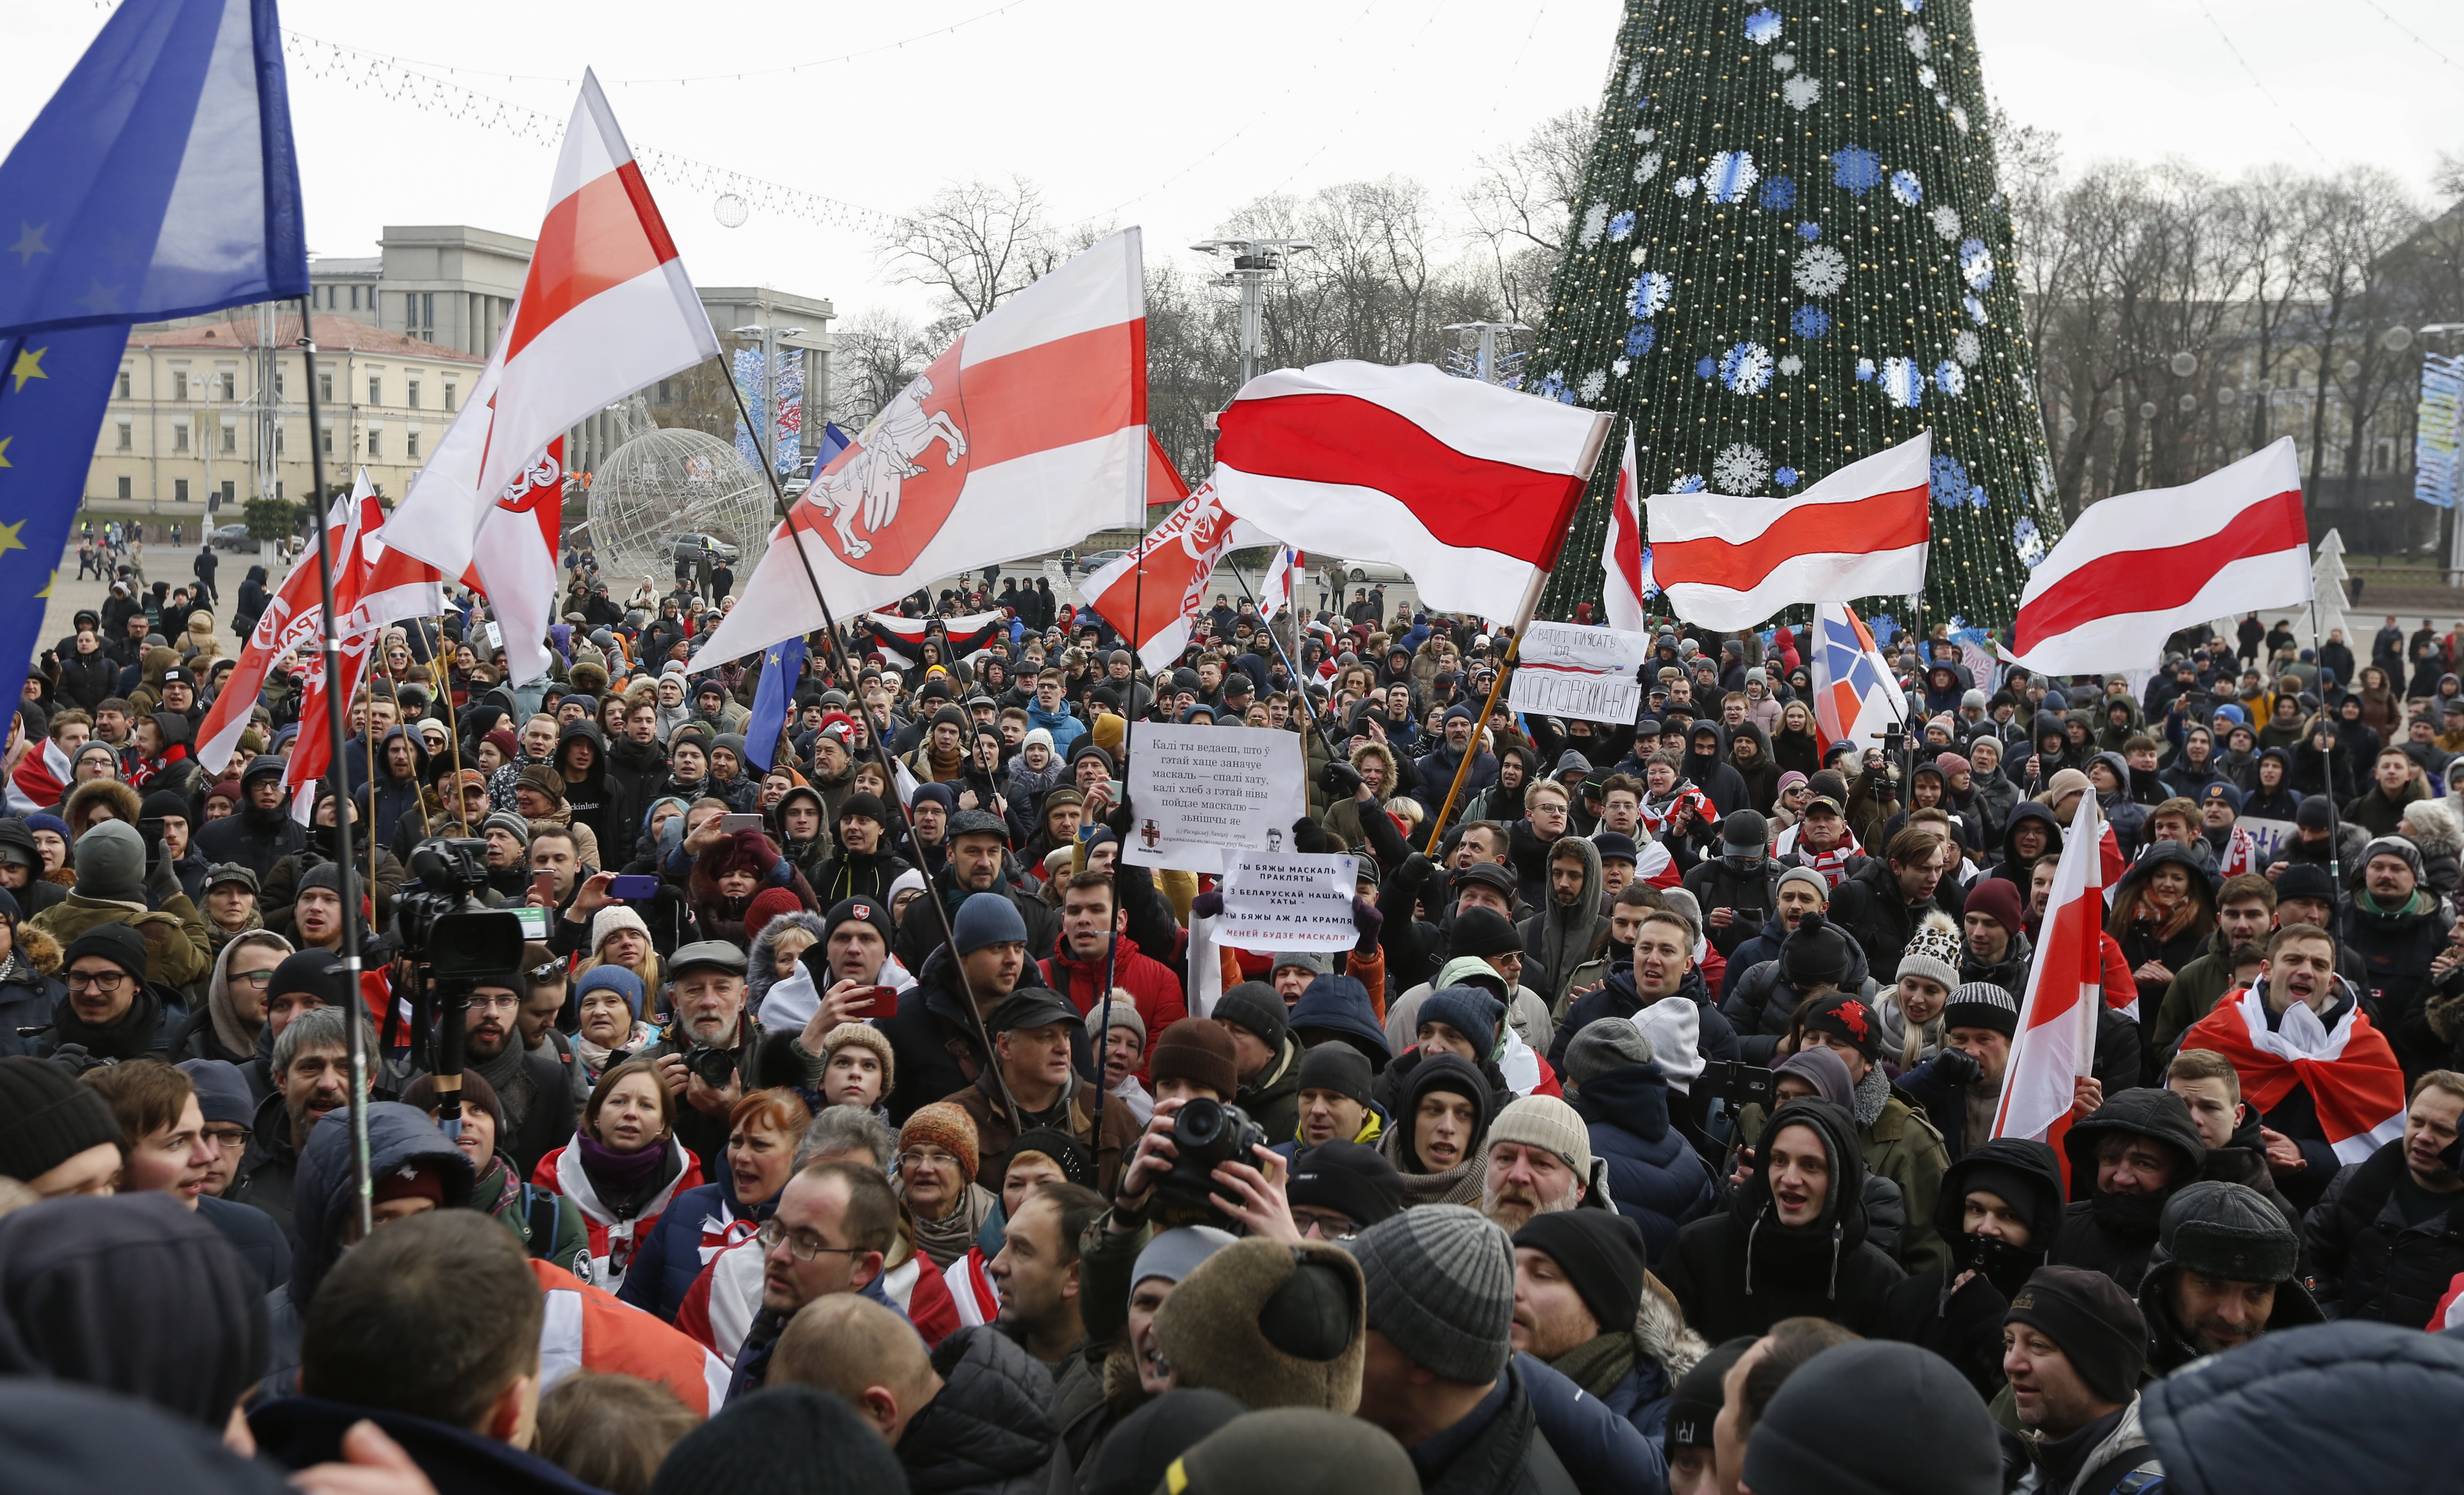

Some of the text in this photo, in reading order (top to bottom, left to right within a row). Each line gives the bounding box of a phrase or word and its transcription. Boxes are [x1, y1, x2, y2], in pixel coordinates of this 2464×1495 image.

[1523, 622, 1616, 649] ХВАТИТ ПЛЯСАТЬ
[1549, 645, 1569, 657] ПОД
[1153, 739, 1176, 750] Калі
[1197, 744, 1240, 754] ведаеш,
[1243, 746, 1262, 754] што
[1264, 747, 1270, 757] ў
[1161, 756, 1261, 770] гэтай хаце заначуе
[1152, 770, 1196, 779] маскаль
[1213, 772, 1242, 782] спалі
[1245, 775, 1269, 786] хату,
[1153, 783, 1175, 792] калі
[1179, 785, 1203, 794] хлеб
[1214, 788, 1242, 797] гэтай
[1246, 788, 1268, 799] нівы
[571, 802, 599, 811] ckinlute
[1162, 798, 1198, 808] пойдзе
[1201, 801, 1246, 812] маскалю
[1181, 813, 1226, 824] зьнішчы
[1260, 873, 1313, 883] ПРАКЛЯТЫ
[1240, 889, 1304, 898] БЕЛАРУСКАЙ
[1313, 917, 1352, 925] КРАМЛЯ
[1226, 929, 1350, 941] МЕНЕЙ БУДЗЕ МАСКАЛЯ!
